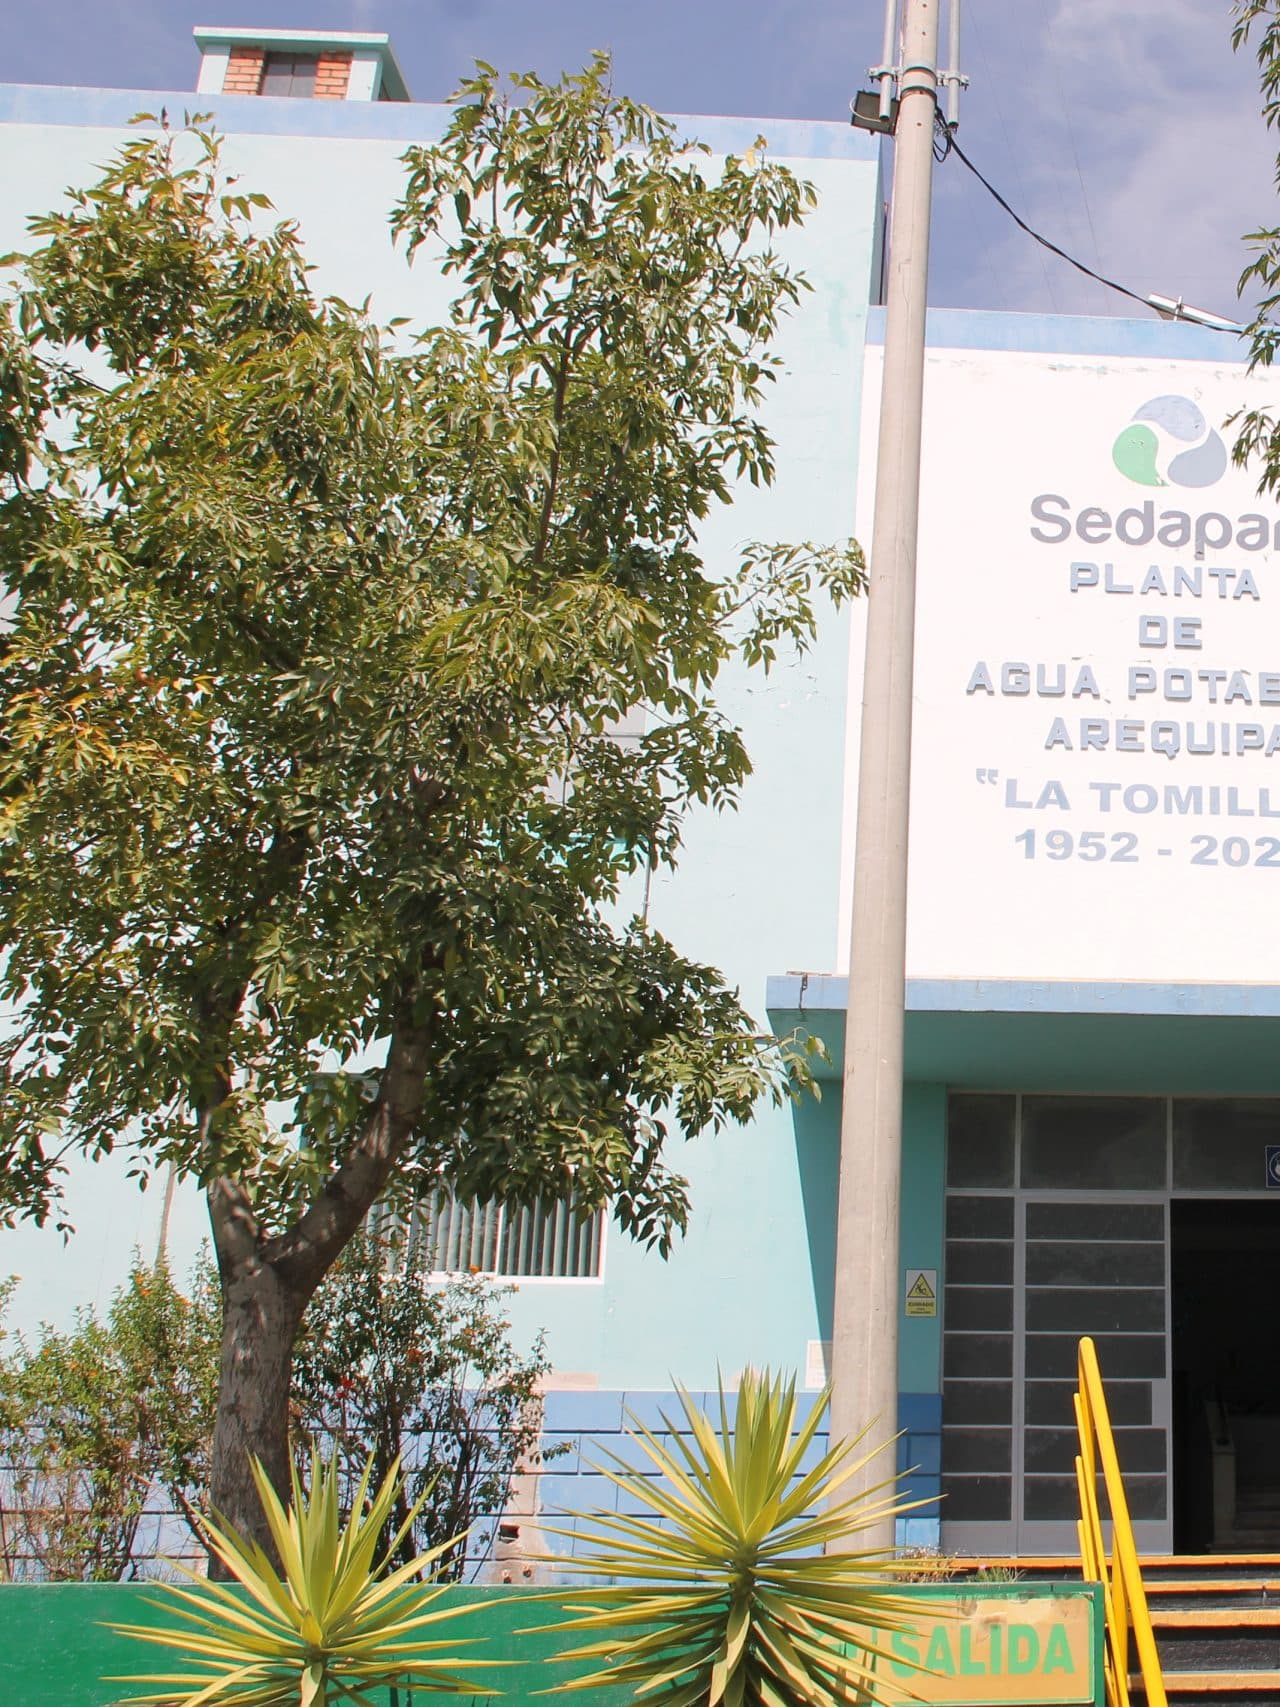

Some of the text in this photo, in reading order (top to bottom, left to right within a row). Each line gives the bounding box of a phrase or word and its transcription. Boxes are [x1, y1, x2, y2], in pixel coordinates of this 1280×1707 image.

[1069, 561, 1261, 600] PLANTA
[1138, 614, 1203, 649] DE
[966, 661, 1101, 698] AGUA
[1014, 828, 1139, 863] 1952
[1157, 848, 1172, 857] -
[889, 1622, 1076, 1679] SALIDA
